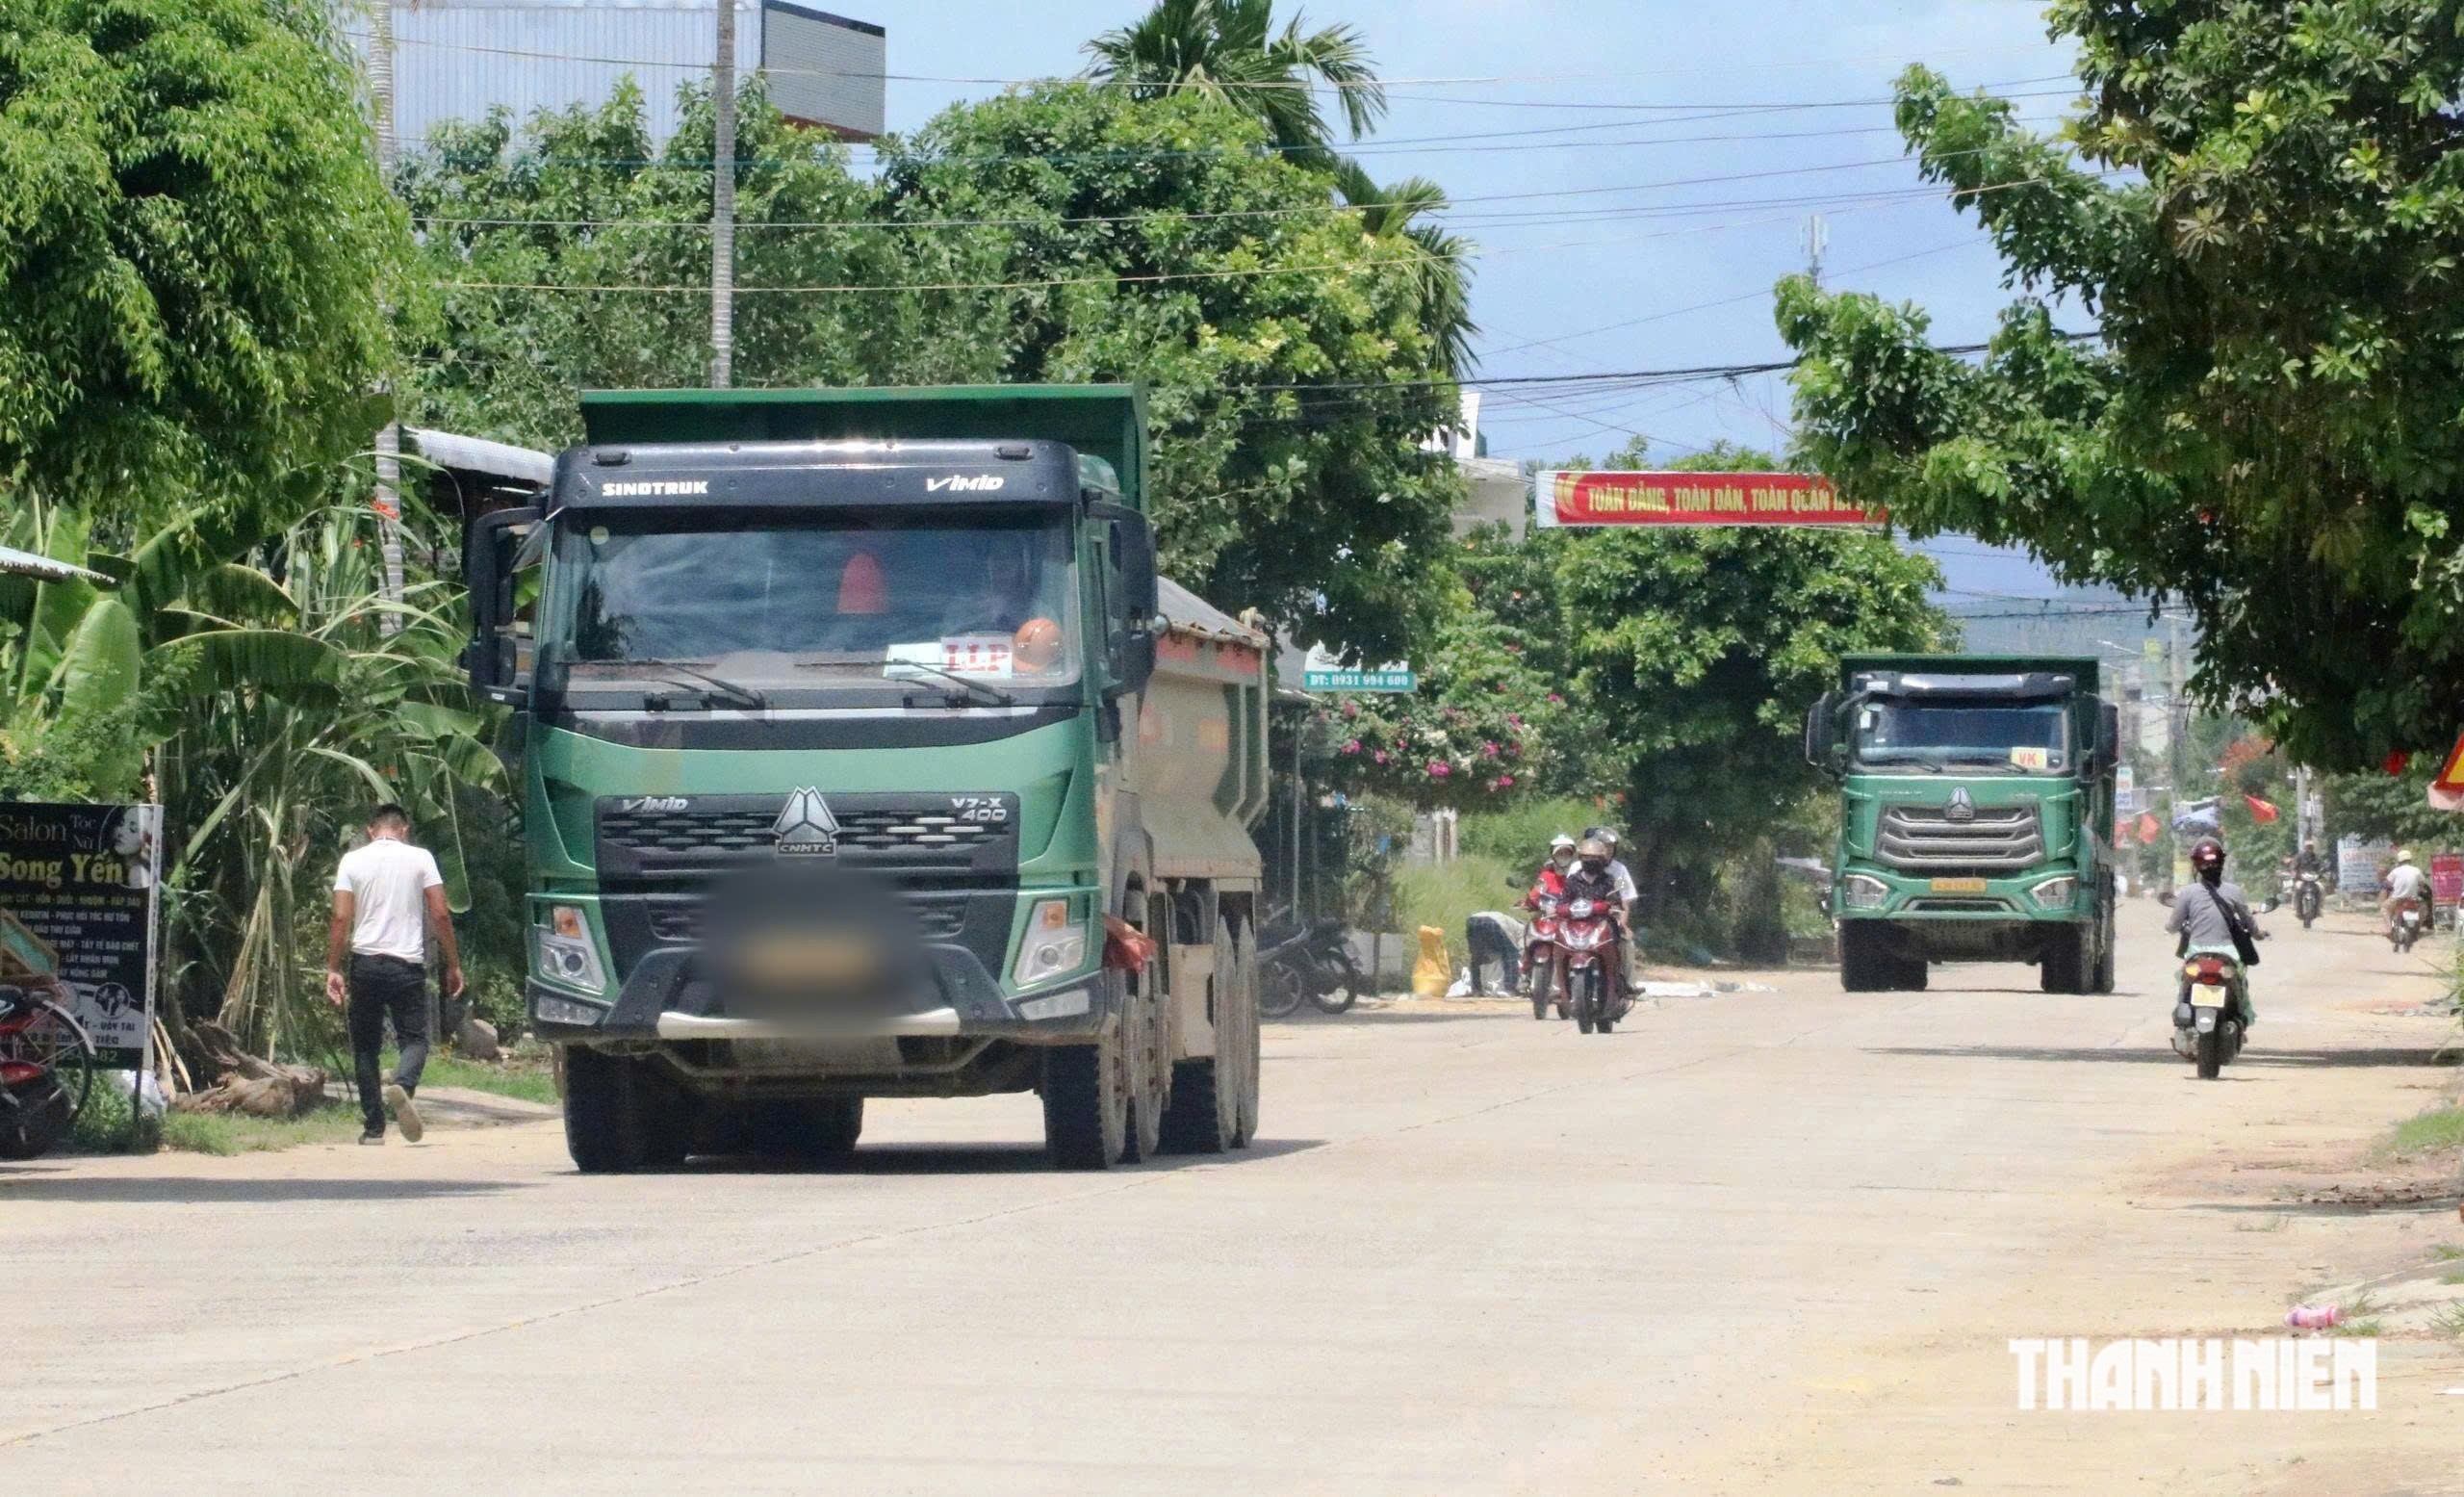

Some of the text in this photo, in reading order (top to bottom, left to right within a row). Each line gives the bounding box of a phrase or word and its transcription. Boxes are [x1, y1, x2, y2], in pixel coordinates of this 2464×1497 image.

[603, 481, 708, 496] SINOTRUK
[1587, 483, 1624, 511] TOÀN
[1674, 483, 1710, 511] TOÀN
[1714, 484, 1747, 514] DÂN,
[1751, 484, 1787, 511] TOÀN
[2017, 752, 2037, 766] VK
[951, 797, 1002, 809] V7-X
[961, 809, 1007, 821] 400
[0, 814, 66, 841] Salon
[779, 843, 833, 852] CNHTC
[0, 848, 123, 890] Song Yến
